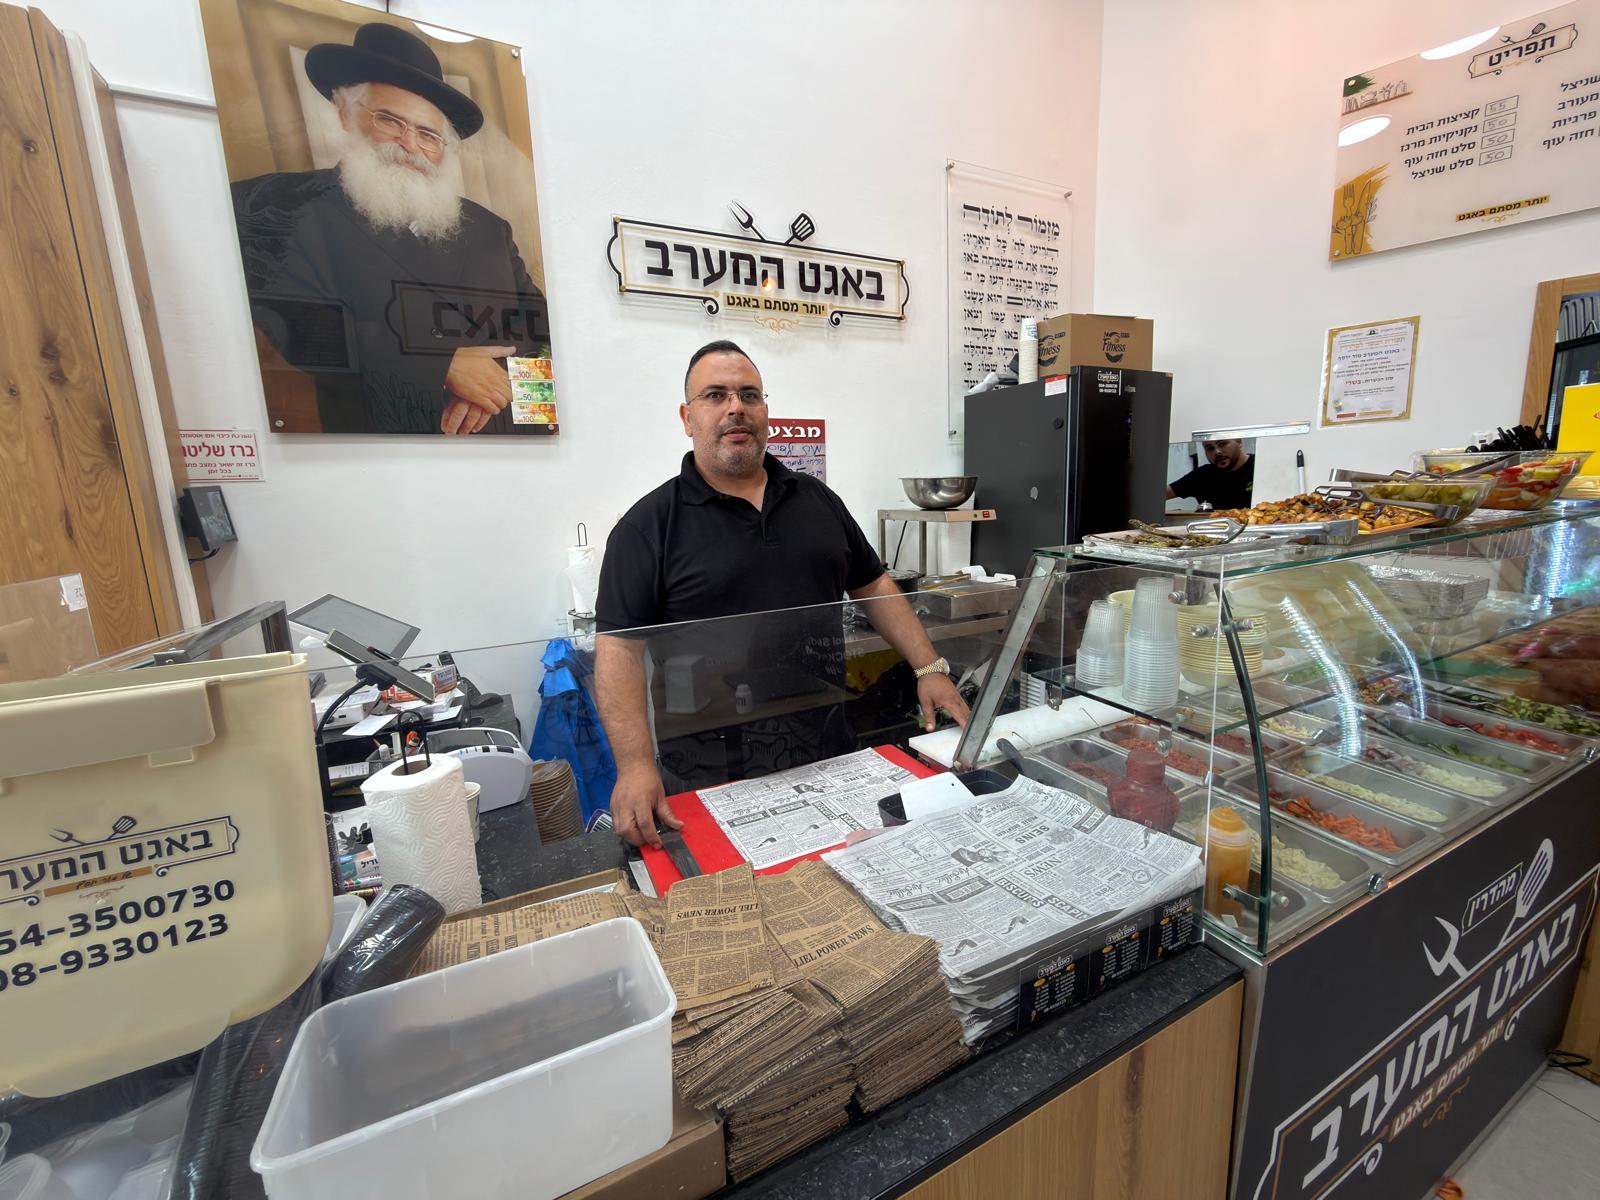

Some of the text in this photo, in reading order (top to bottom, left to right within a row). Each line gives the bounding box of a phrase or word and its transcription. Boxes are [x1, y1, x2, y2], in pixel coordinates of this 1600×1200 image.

[1488, 35, 1555, 67] תפריט
[1560, 74, 1600, 93] שניצל
[1557, 92, 1600, 110] מעורב
[1406, 108, 1480, 136] קציצות הבית
[1551, 110, 1597, 129] פרגיות
[1400, 124, 1479, 152] נקניקיות מרגז
[1487, 134, 1508, 144] 50
[1542, 127, 1595, 150] חזה עוף
[1404, 141, 1477, 168] סלט חזה עוף
[1486, 151, 1505, 161] 50
[1411, 157, 1474, 180] סלט שניצל
[1458, 196, 1549, 222] יותר מסתם באגט
[644, 239, 886, 301] באגט המערב
[726, 294, 826, 316] יותר מסתם באגט
[229, 444, 256, 458] ברז
[1014, 825, 1050, 845] SEINS
[0, 827, 213, 892] באגט המער
[1022, 856, 1062, 878] NEWS
[676, 903, 759, 920] LIEL POWER NEWS
[1467, 872, 1517, 928] מהדרין
[0, 879, 236, 956] 54-3500730
[793, 924, 875, 968] LIEL POWER NEWS
[1301, 903, 1577, 1191] באגט המערב
[1392, 1019, 1504, 1139] יותר מסתם באגט
